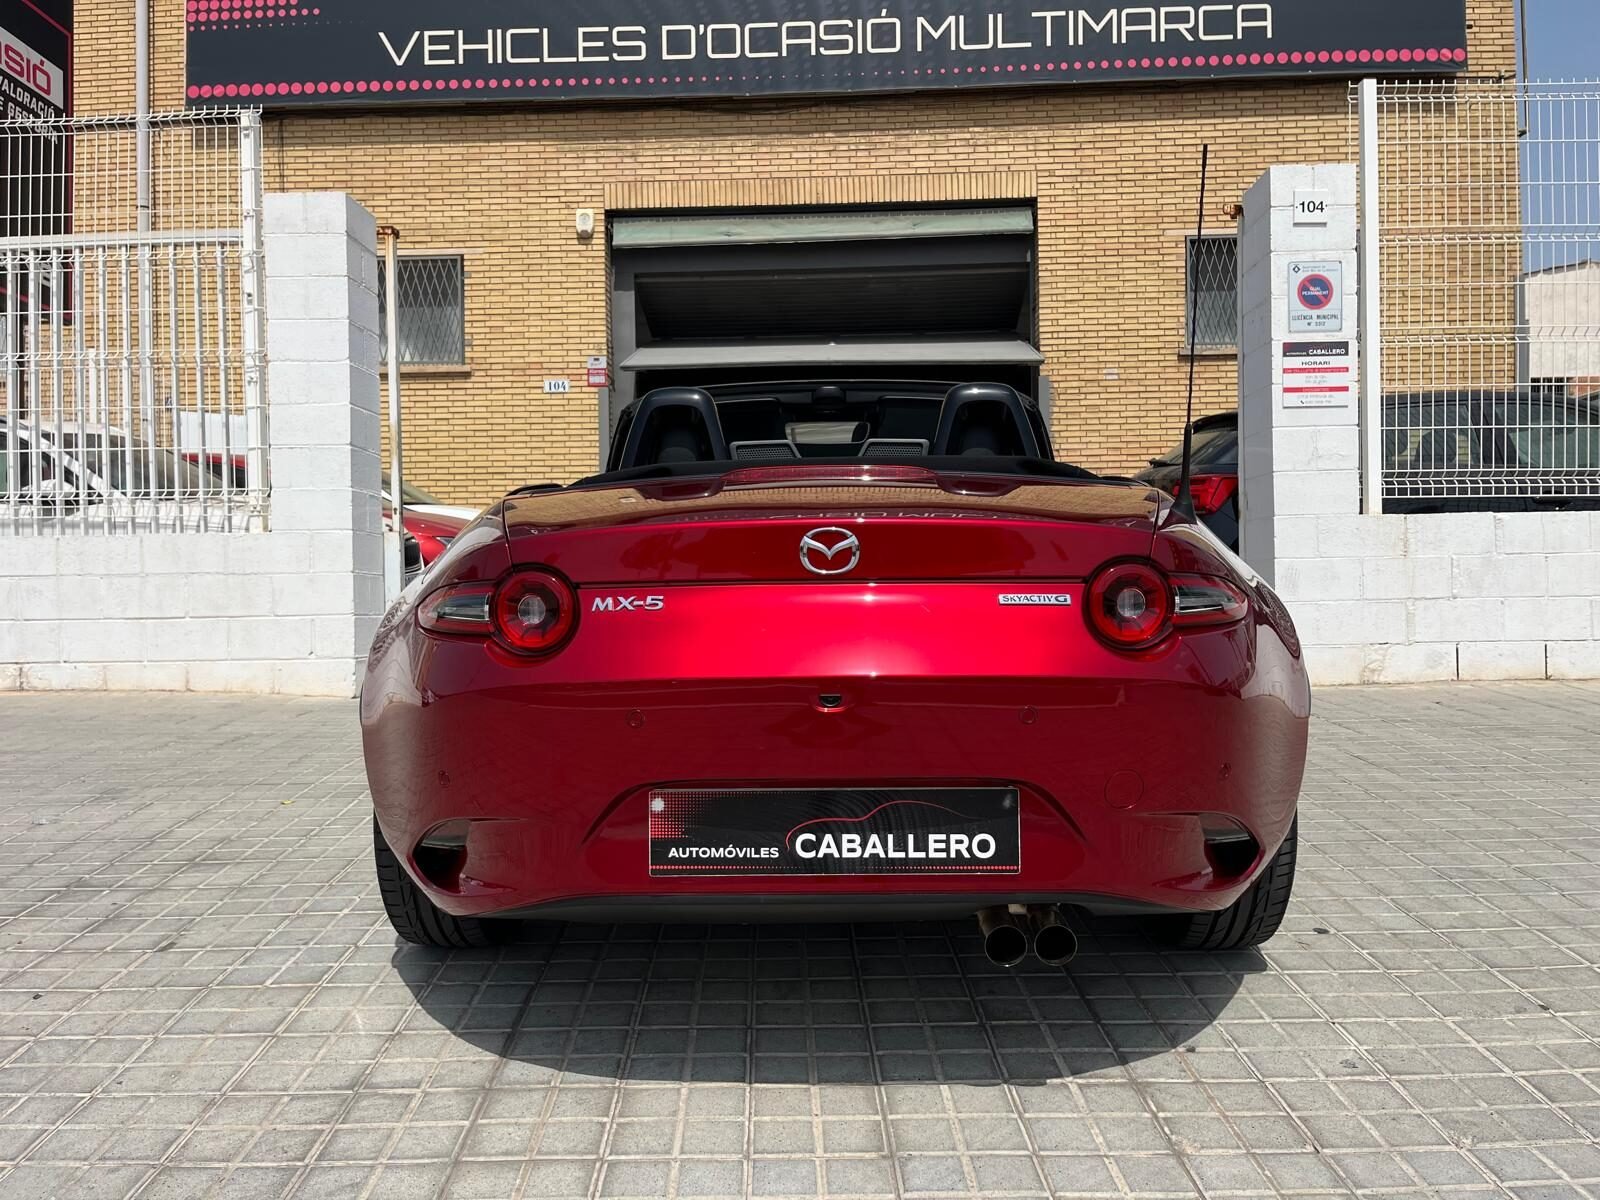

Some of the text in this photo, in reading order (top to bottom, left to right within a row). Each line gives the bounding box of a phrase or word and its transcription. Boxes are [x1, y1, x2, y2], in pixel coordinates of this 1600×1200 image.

[378, 3, 1273, 67] VEHICLES D'OCASIÓ MULTIMARCA
[0, 40, 51, 97] SIÓ
[1299, 200, 1325, 213] 104
[548, 381, 567, 391] 104
[591, 595, 665, 612] MX-5
[667, 833, 997, 860] AUTOMÓVILES CABALLERO
